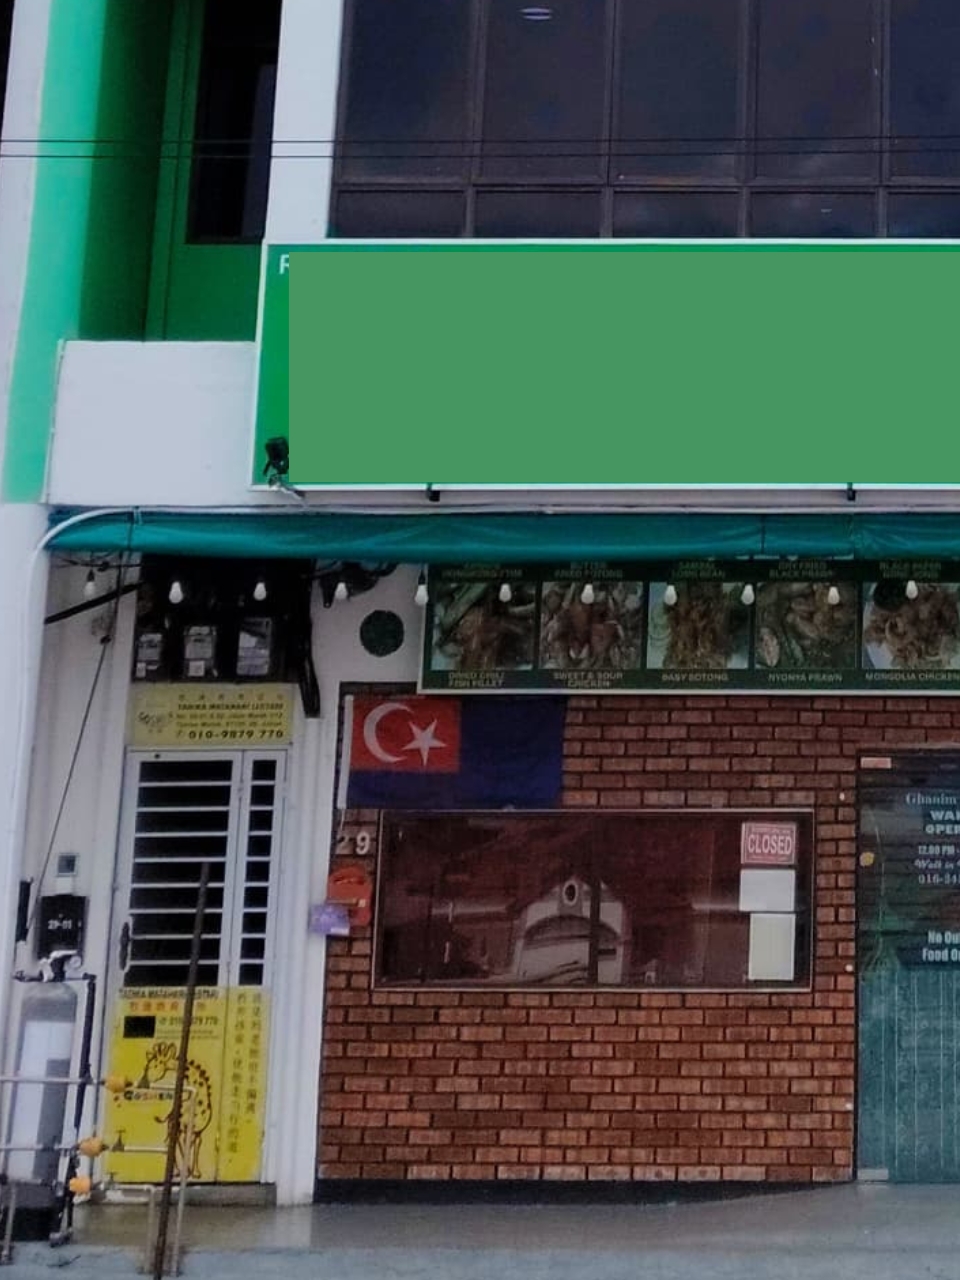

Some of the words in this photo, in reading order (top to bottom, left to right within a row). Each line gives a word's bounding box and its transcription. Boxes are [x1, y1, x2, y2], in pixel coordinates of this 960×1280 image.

[748, 834, 792, 855] CLOSED
[928, 930, 943, 945] No
[922, 948, 949, 962] Food
